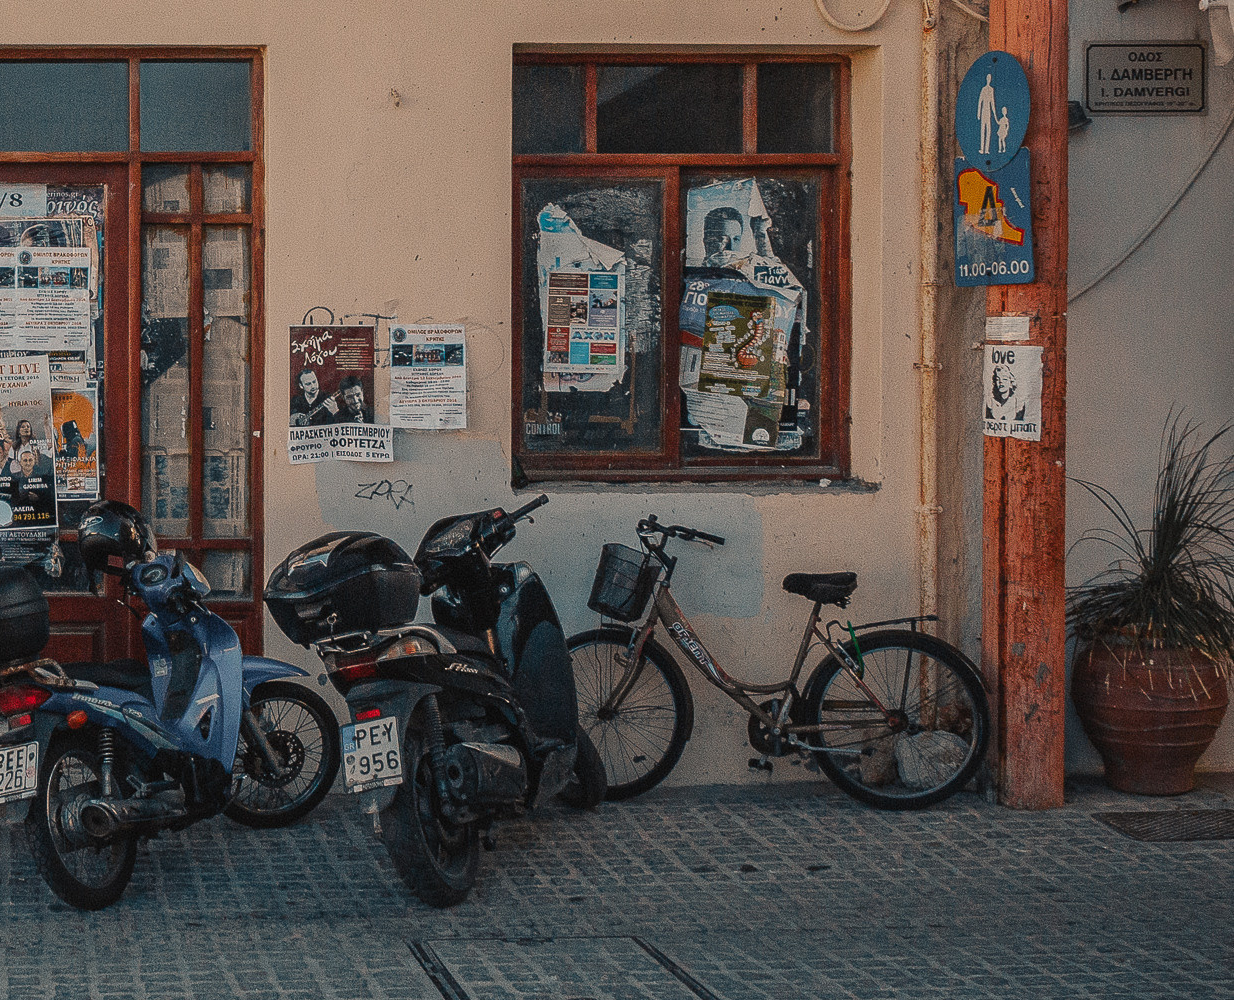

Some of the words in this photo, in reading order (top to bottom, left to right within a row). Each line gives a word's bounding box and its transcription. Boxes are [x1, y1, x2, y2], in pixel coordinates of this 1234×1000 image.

[1128, 51, 1163, 62] ΟΔΟΣ
[1111, 68, 1193, 81] ΔΑΜΒΕΡΓΗ
[1113, 87, 1190, 97] DAMVERGI
[958, 260, 1030, 277] 11.00-06.00
[991, 347, 1016, 365] love
[9, 362, 41, 375] LIVE
[289, 427, 333, 441] ΠΑΡΑΣΚΕΥΗ
[334, 427, 340, 436] 9
[340, 426, 391, 439] ΣΕΠΤΕΜΒΡΙΟΥ
[290, 443, 322, 452] ΦΡΟΥΡΙΟ
[292, 453, 309, 461] ΩΡΑ:
[310, 451, 329, 459] 21:00
[336, 450, 363, 458] ΕΙΣΟΔΟΣ
[371, 451, 390, 459] ΕΥΡΩ
[356, 721, 394, 749] PEY
[359, 750, 399, 775] 956
